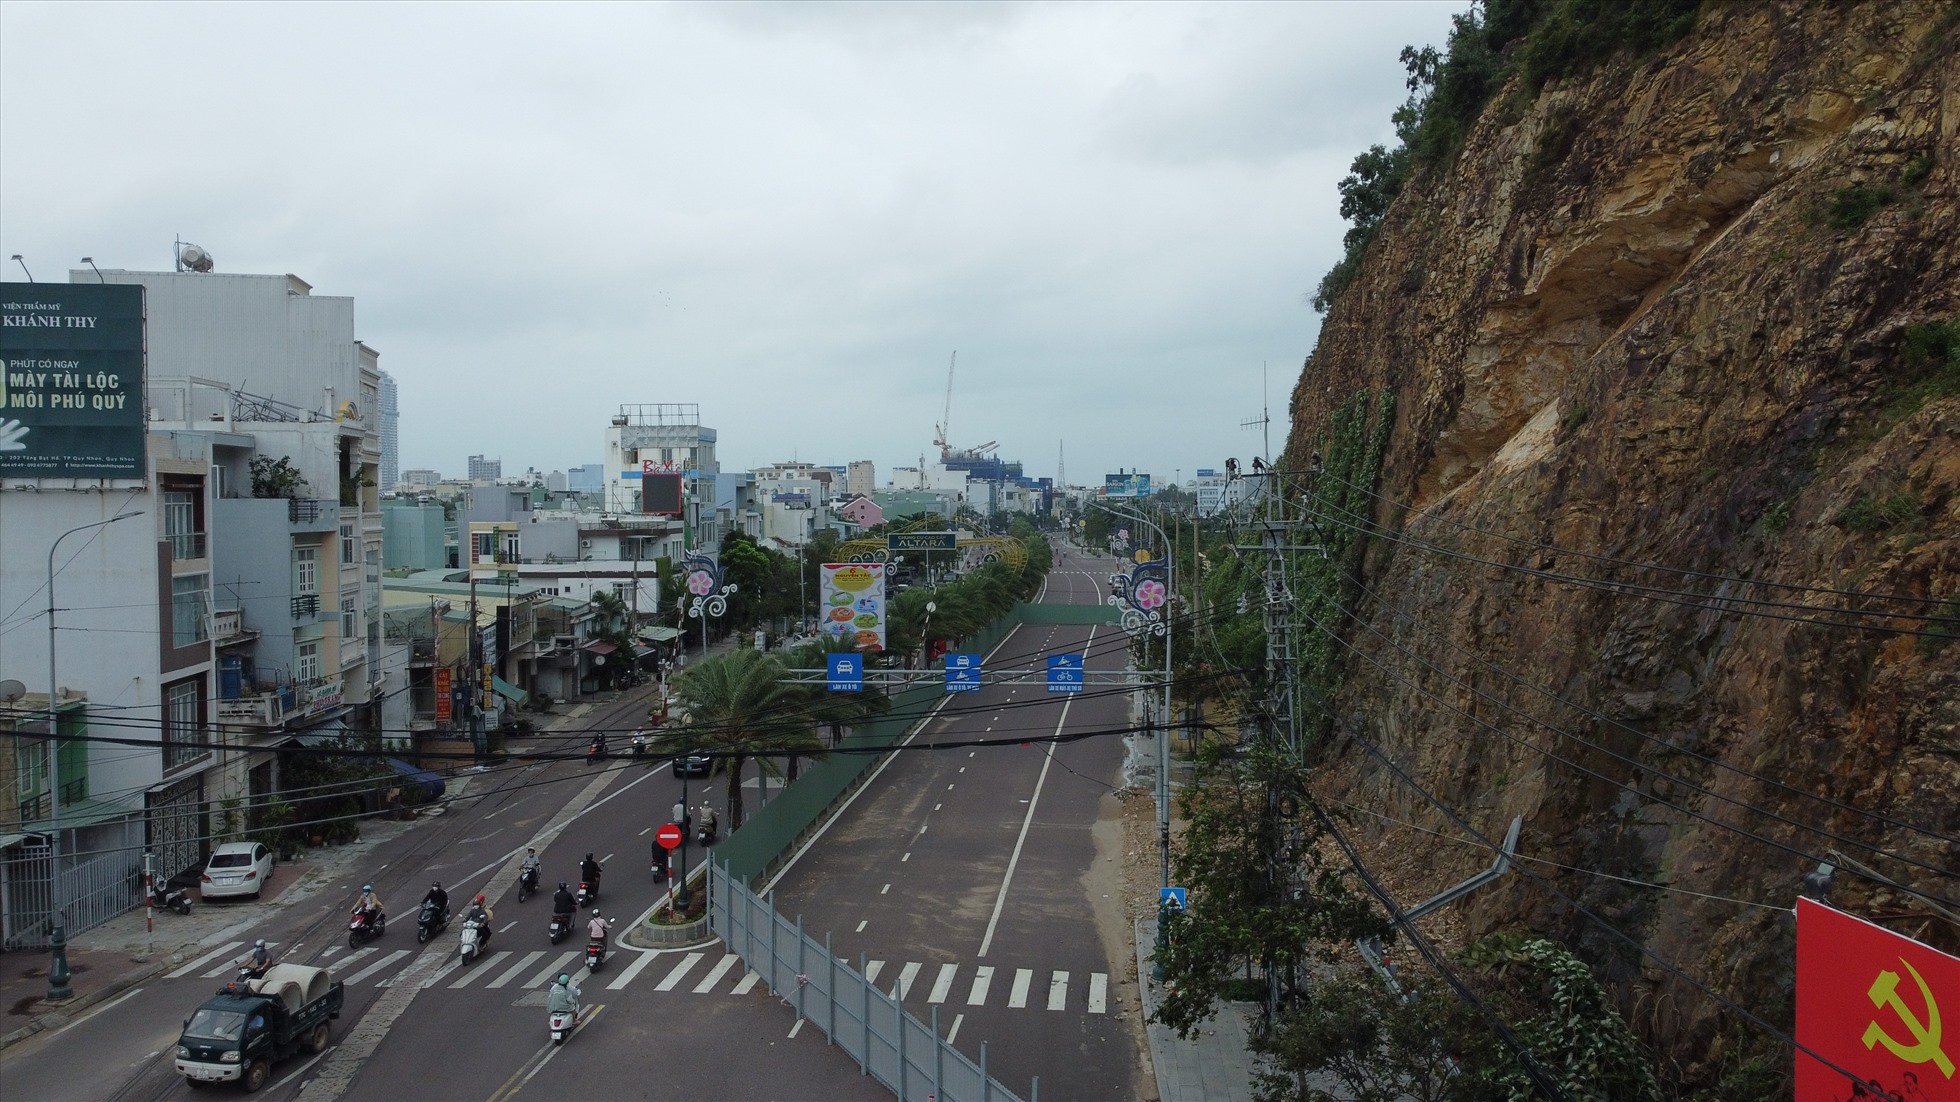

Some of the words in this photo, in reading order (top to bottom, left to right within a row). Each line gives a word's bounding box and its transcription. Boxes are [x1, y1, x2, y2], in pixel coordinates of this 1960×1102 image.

[2, 301, 22, 311] VIỆN
[48, 302, 61, 311] MỸ
[2, 312, 61, 328] KHÁNH
[64, 316, 98, 328] THY
[10, 358, 36, 368] PHÚT
[38, 358, 52, 368] CÓ
[53, 360, 79, 369] NGAY
[10, 369, 47, 388] MÀY
[53, 370, 80, 389] TÀI
[87, 370, 119, 392] LỘC
[11, 390, 43, 408] MÔI
[50, 391, 85, 409] PHÚ
[92, 391, 126, 411] QUÝ
